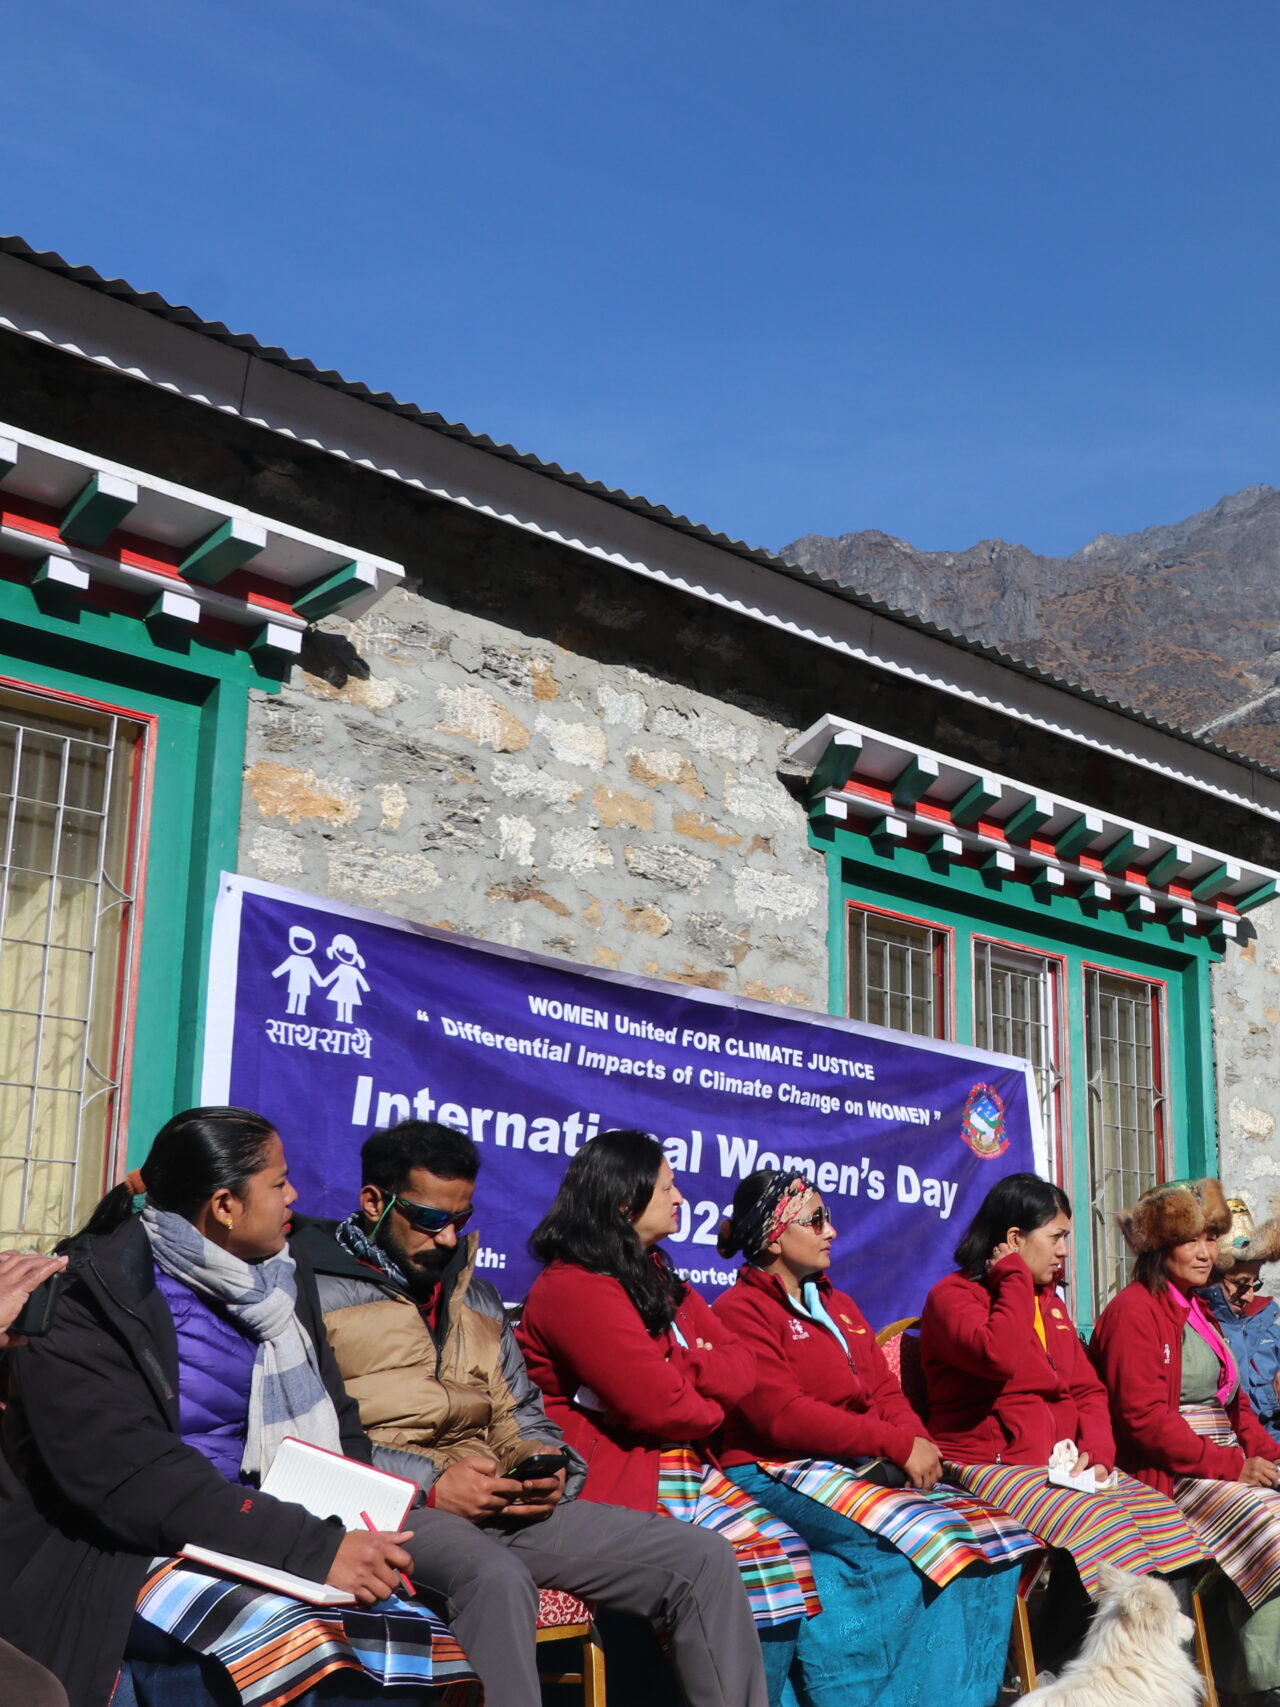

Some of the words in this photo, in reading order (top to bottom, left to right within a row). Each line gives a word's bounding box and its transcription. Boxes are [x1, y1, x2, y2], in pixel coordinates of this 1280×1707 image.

[440, 1016, 573, 1064] Differential
[576, 1044, 667, 1081] Impacts
[672, 1065, 694, 1086] of
[698, 1068, 773, 1100] Climate
[777, 1082, 841, 1115] Change
[844, 1099, 864, 1117] on
[867, 1099, 931, 1127] WOMEN
[527, 995, 609, 1031] WOMEN
[614, 1014, 678, 1045] United
[681, 1029, 721, 1054] FOR
[724, 1037, 804, 1068] CLIMATE
[807, 1053, 876, 1081] JUSTICE
[351, 1075, 703, 1174] Internatial
[896, 1164, 959, 1220] Day
